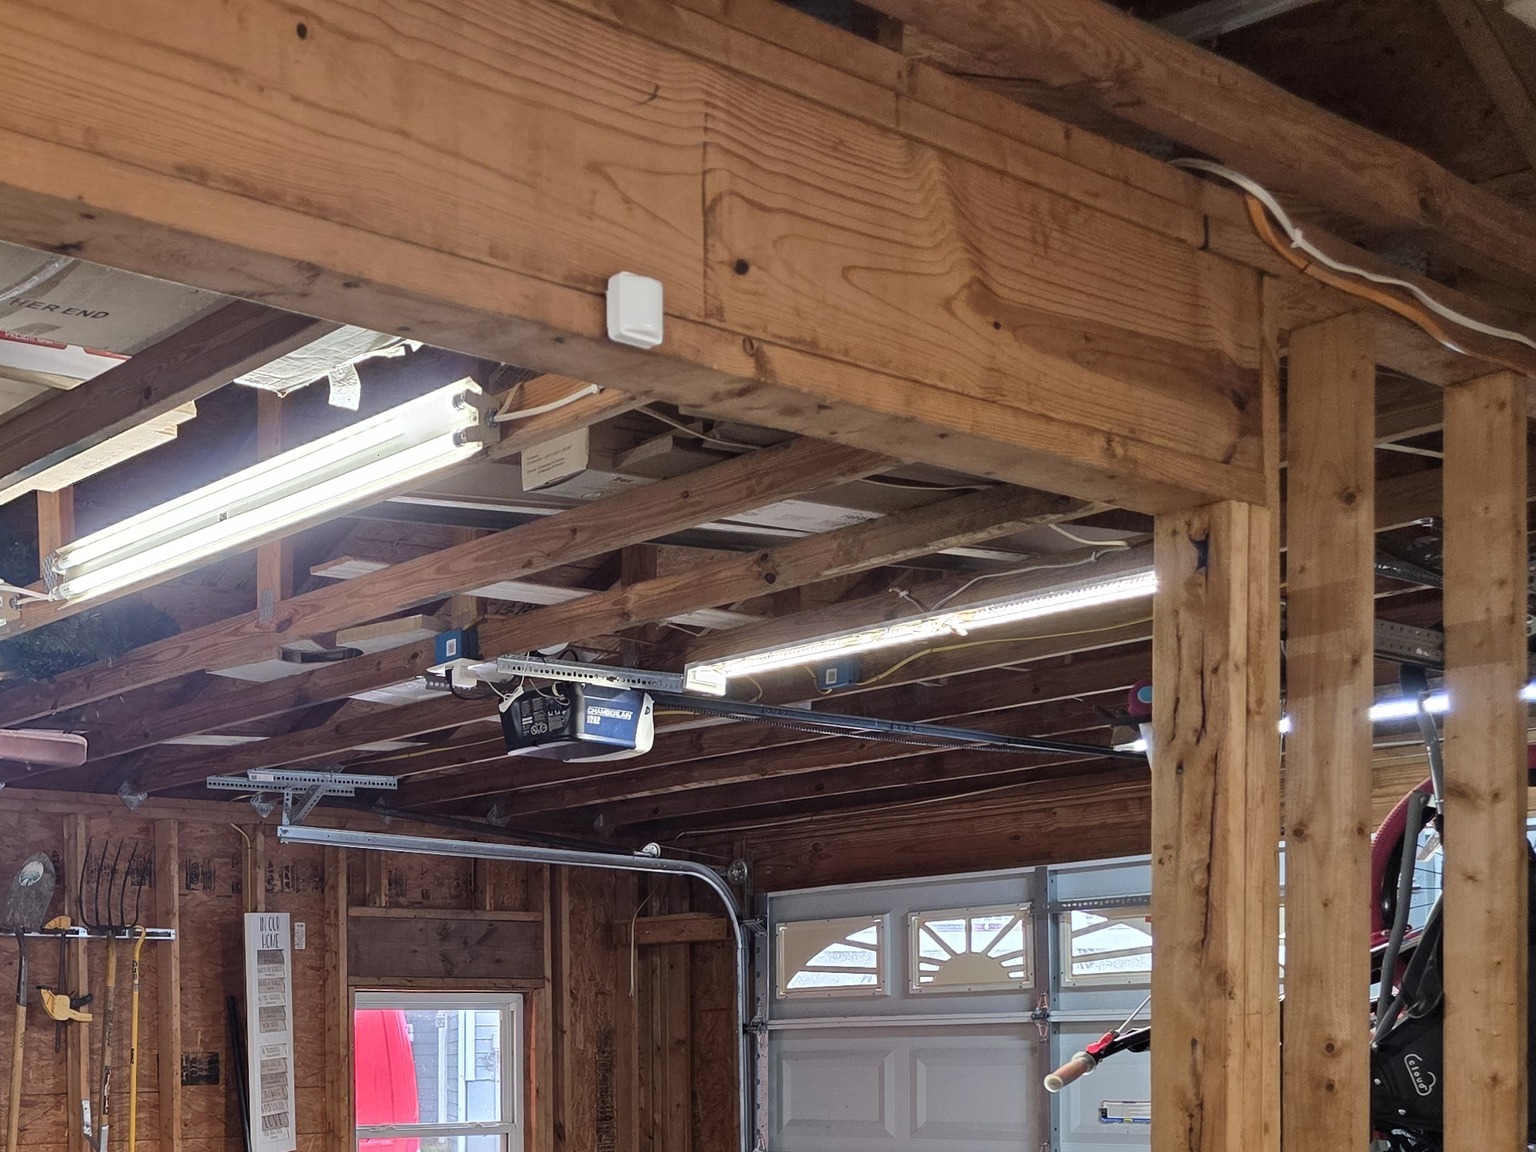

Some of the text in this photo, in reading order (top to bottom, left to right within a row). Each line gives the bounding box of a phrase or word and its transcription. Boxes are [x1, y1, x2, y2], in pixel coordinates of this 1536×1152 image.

[61, 307, 110, 319] END
[1409, 1060, 1428, 1090] cloud
[264, 1114, 283, 1129] LOVE
